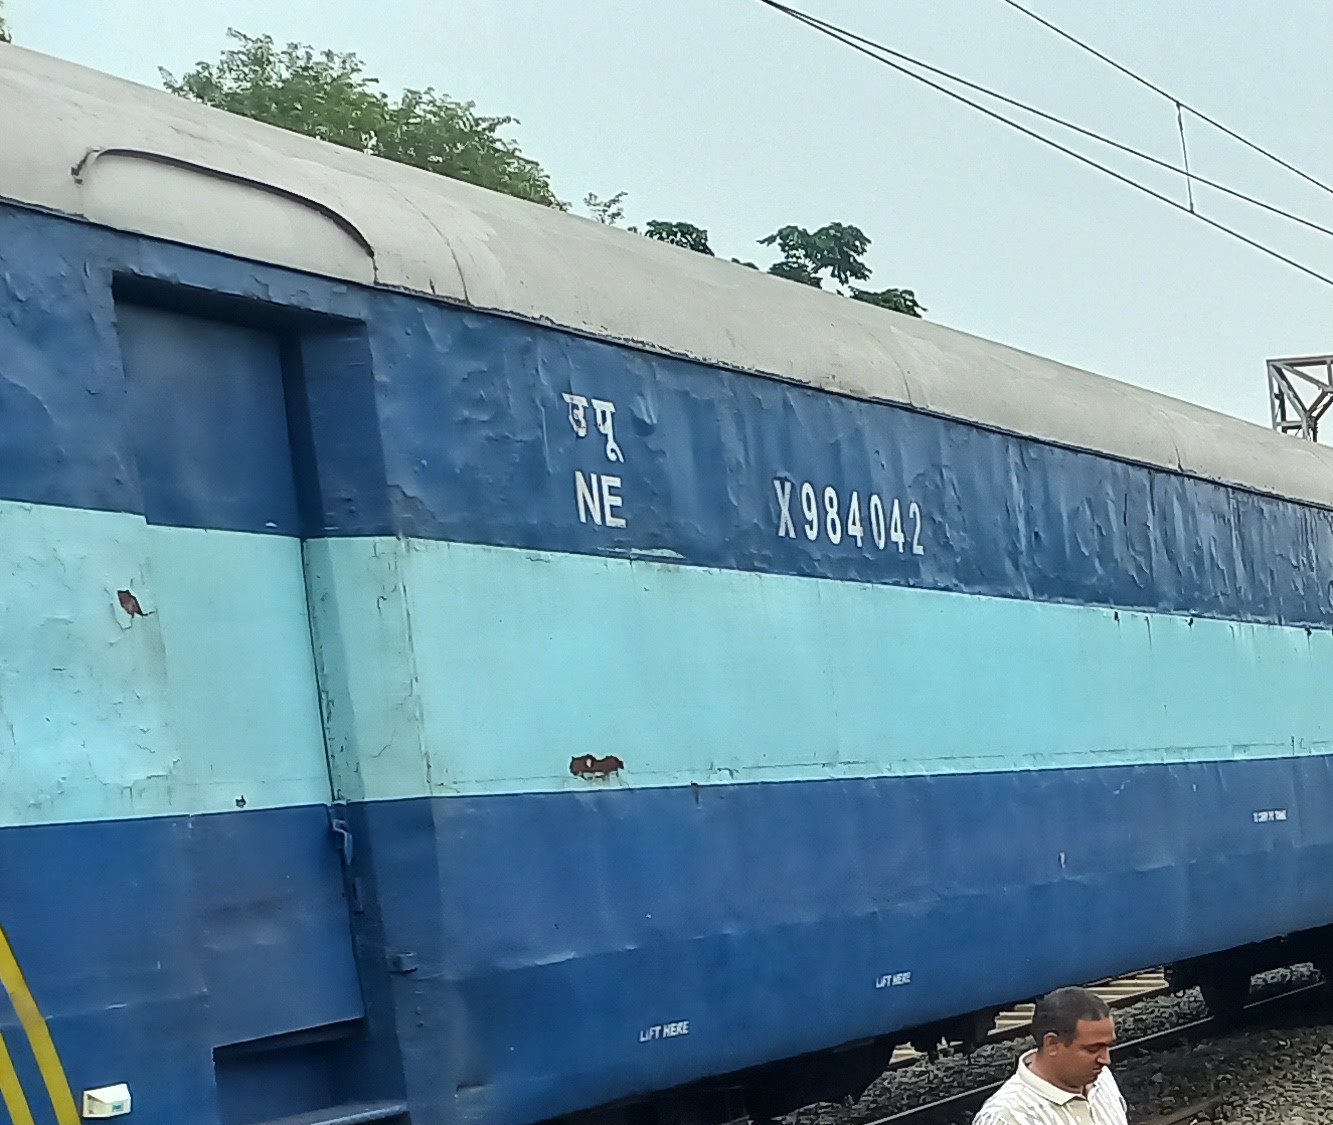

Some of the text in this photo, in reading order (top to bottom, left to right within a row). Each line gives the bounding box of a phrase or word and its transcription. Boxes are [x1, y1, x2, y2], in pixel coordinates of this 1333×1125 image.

[574, 470, 628, 529] NE
[772, 477, 925, 556] X984042
[639, 1020, 690, 1042] LIFT HERE
